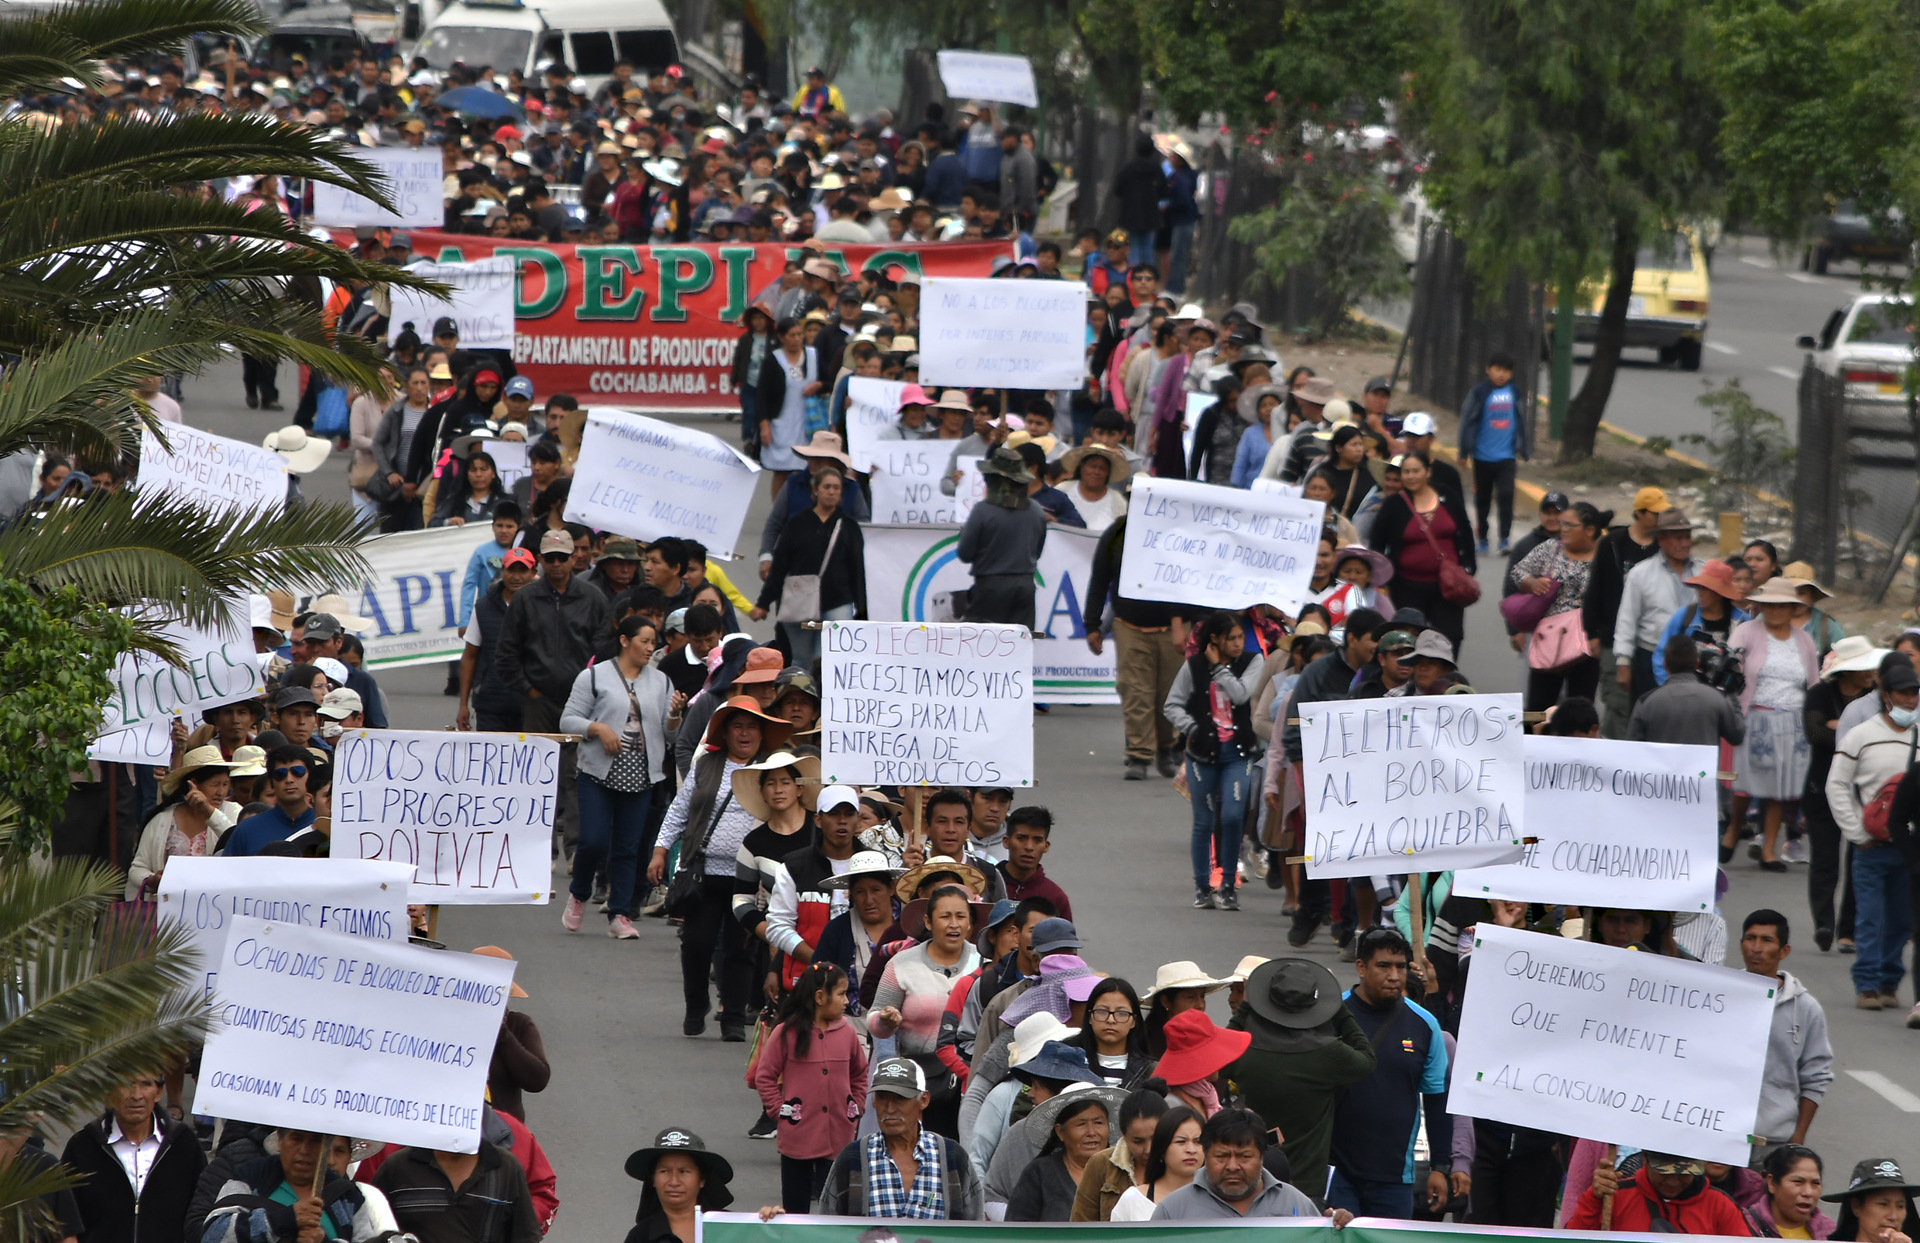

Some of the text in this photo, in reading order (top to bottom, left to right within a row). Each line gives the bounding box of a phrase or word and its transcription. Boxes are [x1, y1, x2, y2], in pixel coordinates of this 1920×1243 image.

[941, 293, 960, 310] NO
[967, 294, 977, 309] A
[629, 336, 649, 366] DE
[589, 371, 707, 394] COCHABAMBA
[608, 420, 676, 451] PROGRAMAS
[226, 448, 279, 478] VACAS
[615, 457, 660, 478] DEBEN
[889, 452, 929, 477] LAS
[222, 473, 262, 500] AIRE
[904, 483, 932, 504] NO
[589, 482, 719, 535] LECHE NACIONAL
[1144, 493, 1320, 545] LAS VACAS NO DEJAN
[1142, 529, 1297, 575] DE COMER NI PRODUCIR
[1152, 562, 1200, 586] TODOS
[1205, 572, 1234, 593] LOS
[828, 626, 1015, 658] LOS LECHEROS
[834, 662, 1023, 699] NECESITAMOS VIAS
[1046, 666, 1110, 677] PRODUCTORES
[830, 697, 989, 733] LIBRES PARA LA
[829, 731, 959, 761] ENTREGA DE
[1319, 705, 1507, 763] LECHEROS
[339, 738, 556, 786] TODOS QUEREMOS
[874, 761, 1000, 784] PRODUCTOS
[1319, 758, 1497, 813] AL BORDE
[1524, 761, 1700, 805] UNICIPIOS CONSUMAN
[341, 787, 555, 827] EL PROGRESO DE
[1314, 802, 1516, 867] DE LA QUIEBRA
[1552, 840, 1690, 881] COCHABAMBINA
[179, 889, 223, 930] LOS
[320, 905, 391, 940] ESTAMOS
[234, 938, 501, 1007] OCHO DIAS DE BLOQUEO DE CAMINOS
[1504, 950, 1607, 993] QUEREMOS
[221, 1003, 306, 1039] CUANTIOSAS
[1511, 1002, 1688, 1059] QUE FOMENTE
[211, 1071, 478, 1131] OCASIONAN A LOS PRODUCTORES DE LECHE
[1493, 1064, 1725, 1132] AL CONSUMO DE LECHE
